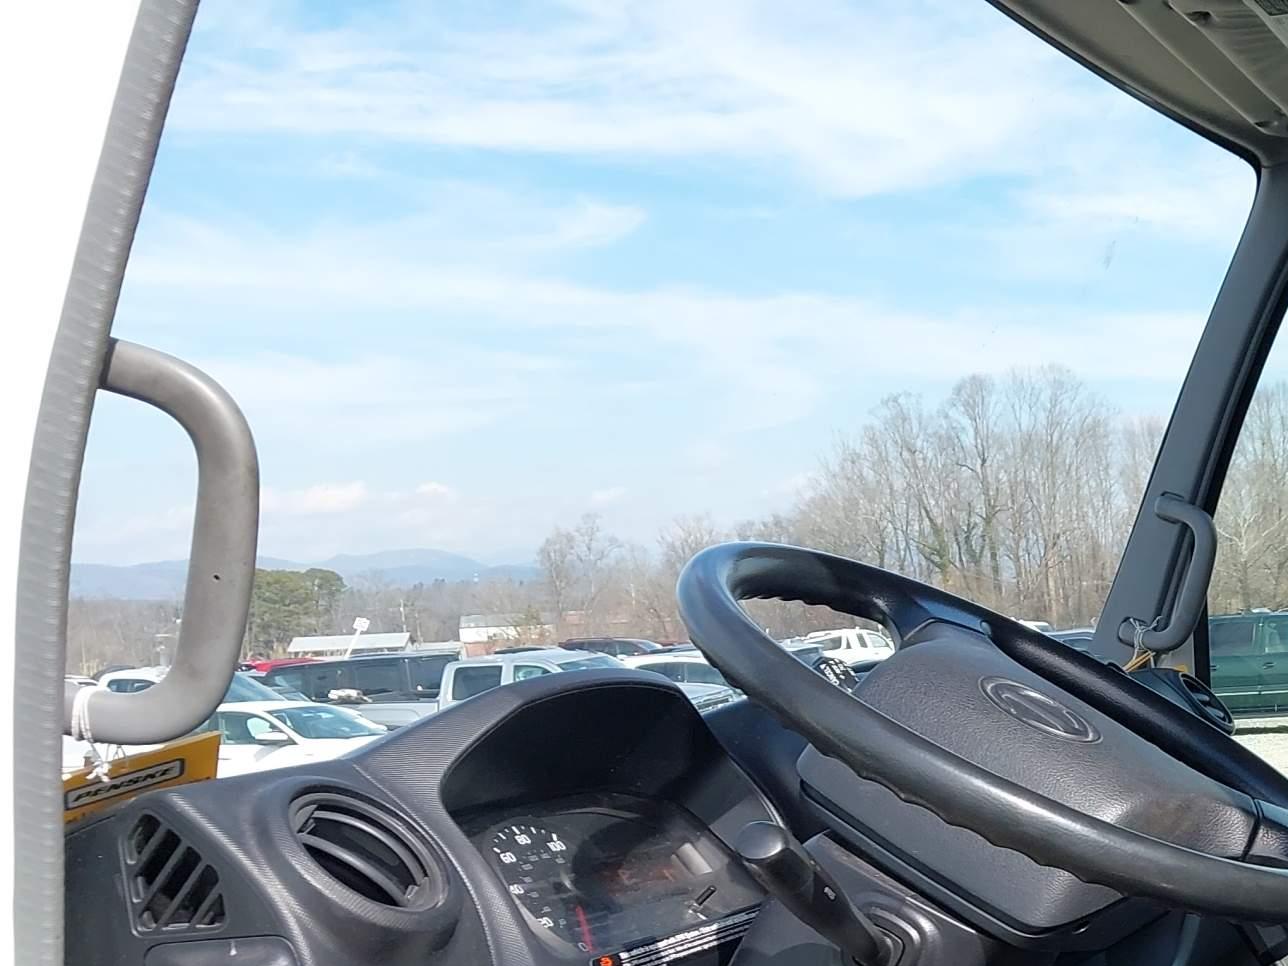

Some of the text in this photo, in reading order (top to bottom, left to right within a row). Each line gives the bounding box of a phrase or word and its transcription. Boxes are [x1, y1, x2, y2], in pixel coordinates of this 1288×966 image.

[72, 767, 174, 802] PENSKE
[515, 834, 531, 845] 80
[546, 840, 567, 852] 100
[500, 852, 517, 864] 60
